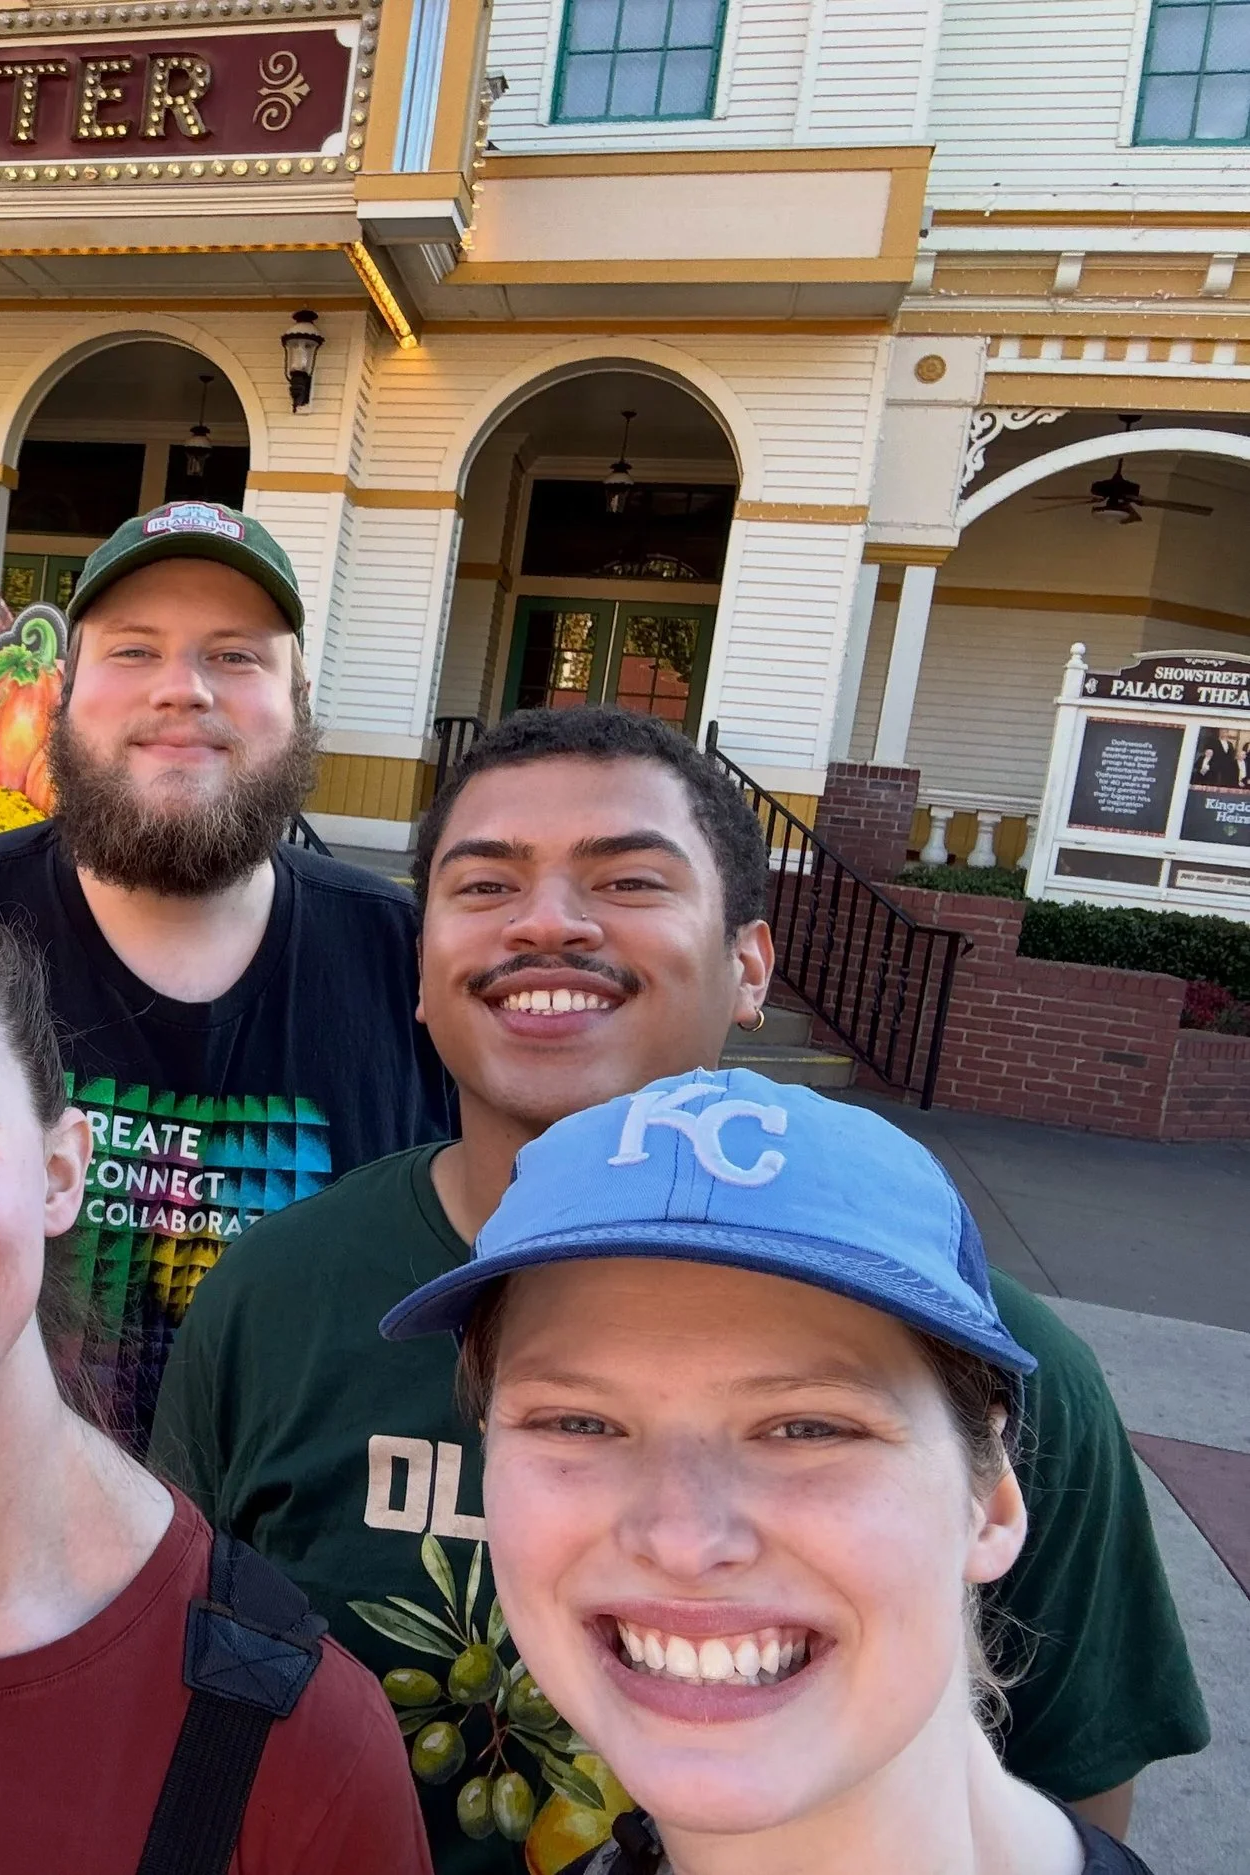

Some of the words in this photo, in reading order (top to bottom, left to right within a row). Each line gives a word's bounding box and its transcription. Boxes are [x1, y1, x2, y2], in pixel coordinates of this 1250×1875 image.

[154, 518, 201, 529] ISLAND
[205, 520, 234, 533] TIME
[1154, 666, 1250, 686] SHOWSTREET
[1110, 679, 1185, 700] PALACE
[607, 1083, 788, 1188] KC
[363, 1434, 489, 1542] OL
